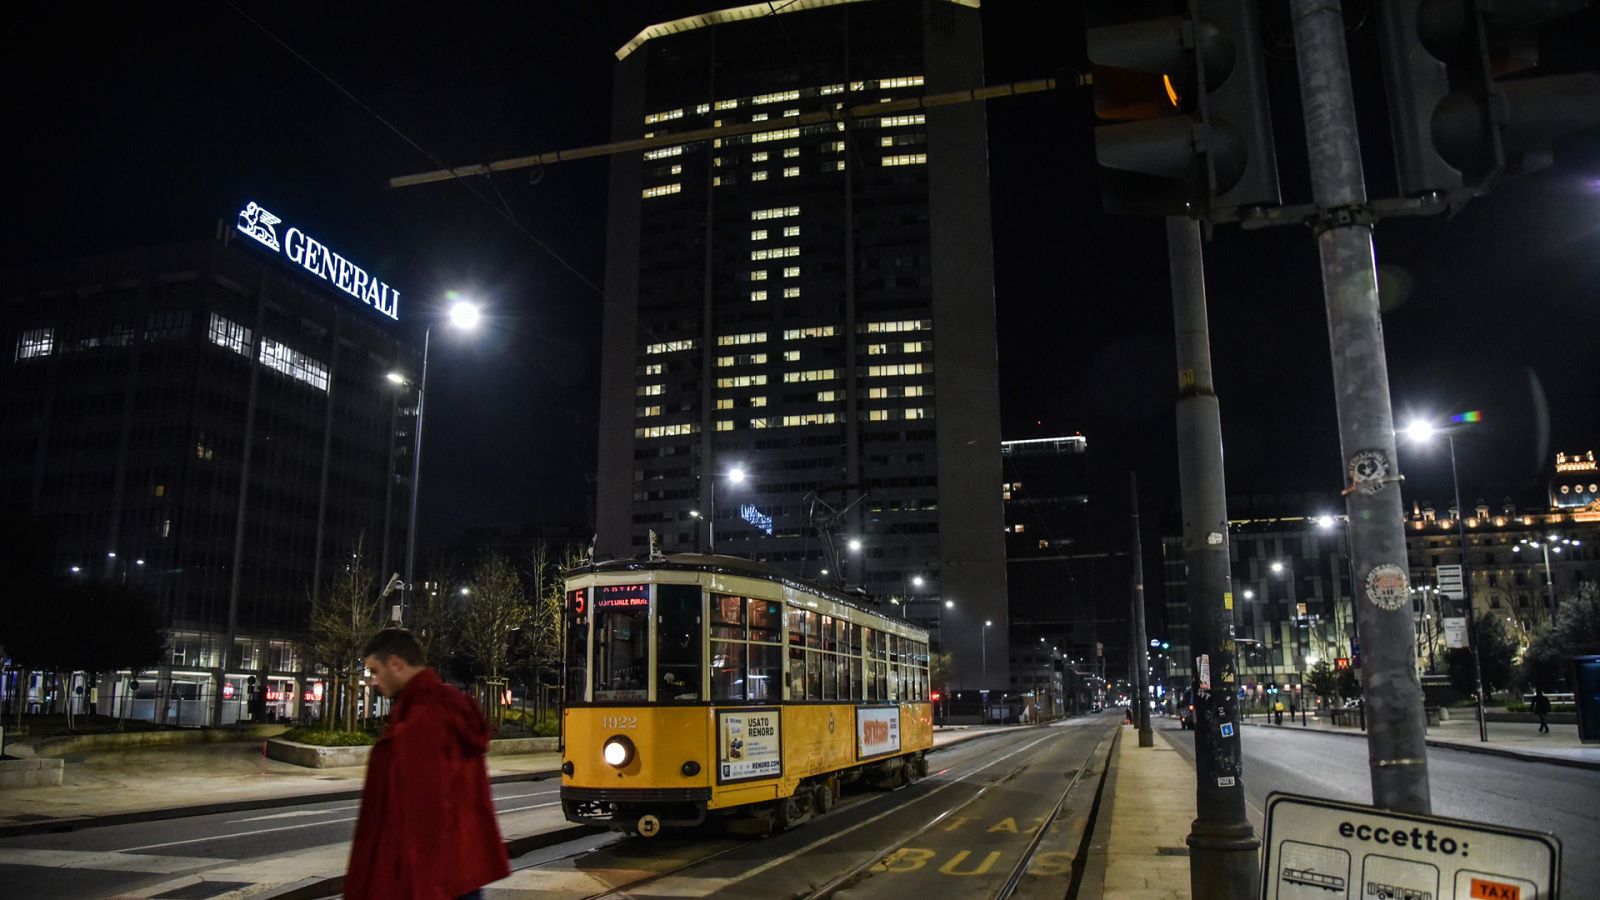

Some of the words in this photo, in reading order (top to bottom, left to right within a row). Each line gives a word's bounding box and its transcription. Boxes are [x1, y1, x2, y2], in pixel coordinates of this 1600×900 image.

[285, 227, 401, 320] GENERALI
[575, 590, 585, 613] 5
[603, 715, 638, 729] 1922
[747, 717, 769, 728] USATO
[748, 726, 775, 738] RENORD
[752, 760, 780, 770] RENORD.COM
[1338, 821, 1469, 857] eccetto:
[868, 847, 1079, 876] BUS
[1480, 884, 1516, 900] TAXI
